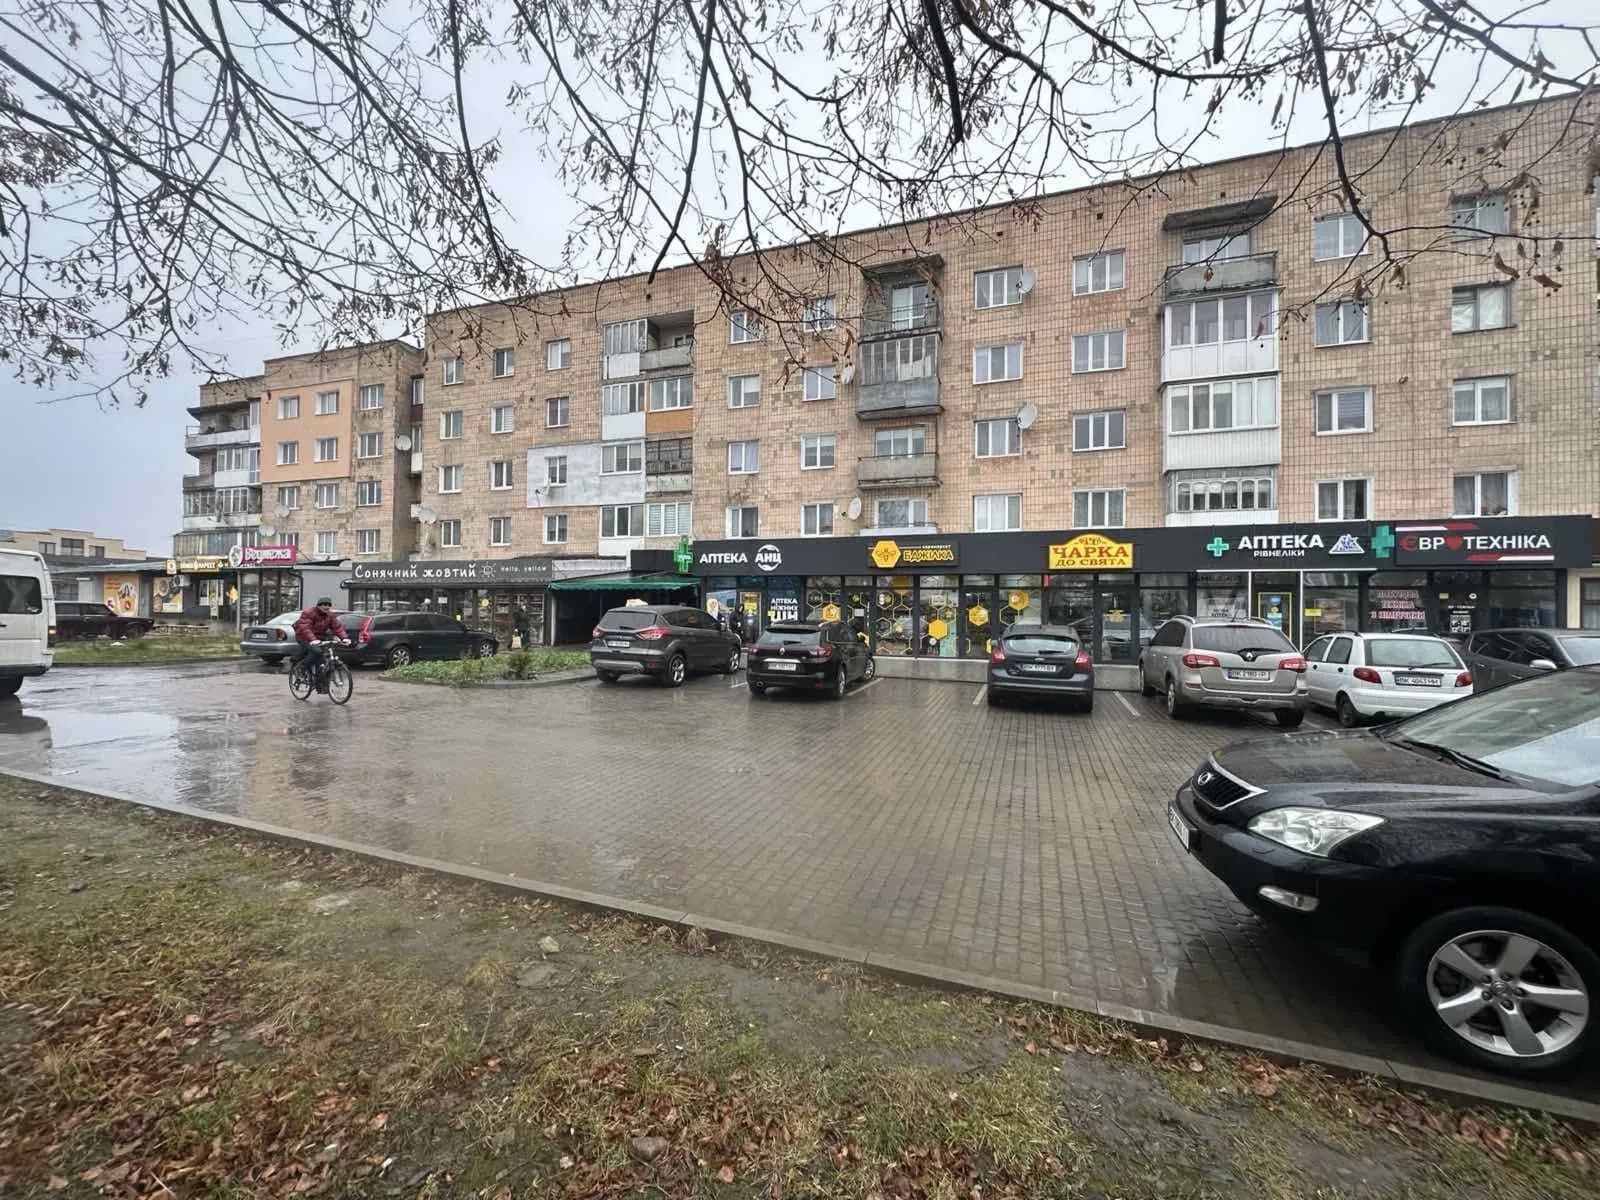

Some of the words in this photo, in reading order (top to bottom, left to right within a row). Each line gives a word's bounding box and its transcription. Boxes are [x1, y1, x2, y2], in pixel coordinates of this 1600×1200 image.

[1238, 534, 1325, 550] АПТЕКА
[699, 552, 748, 564] АПТЕКА
[755, 552, 783, 565] АНЦ
[903, 550, 954, 562] БДЖІЛКА
[1052, 546, 1129, 559] ЧАРКА
[1055, 559, 1076, 567] ДО
[1080, 558, 1126, 566] СВЯТА
[355, 565, 417, 579] Сонячний
[422, 563, 476, 578] жовтий
